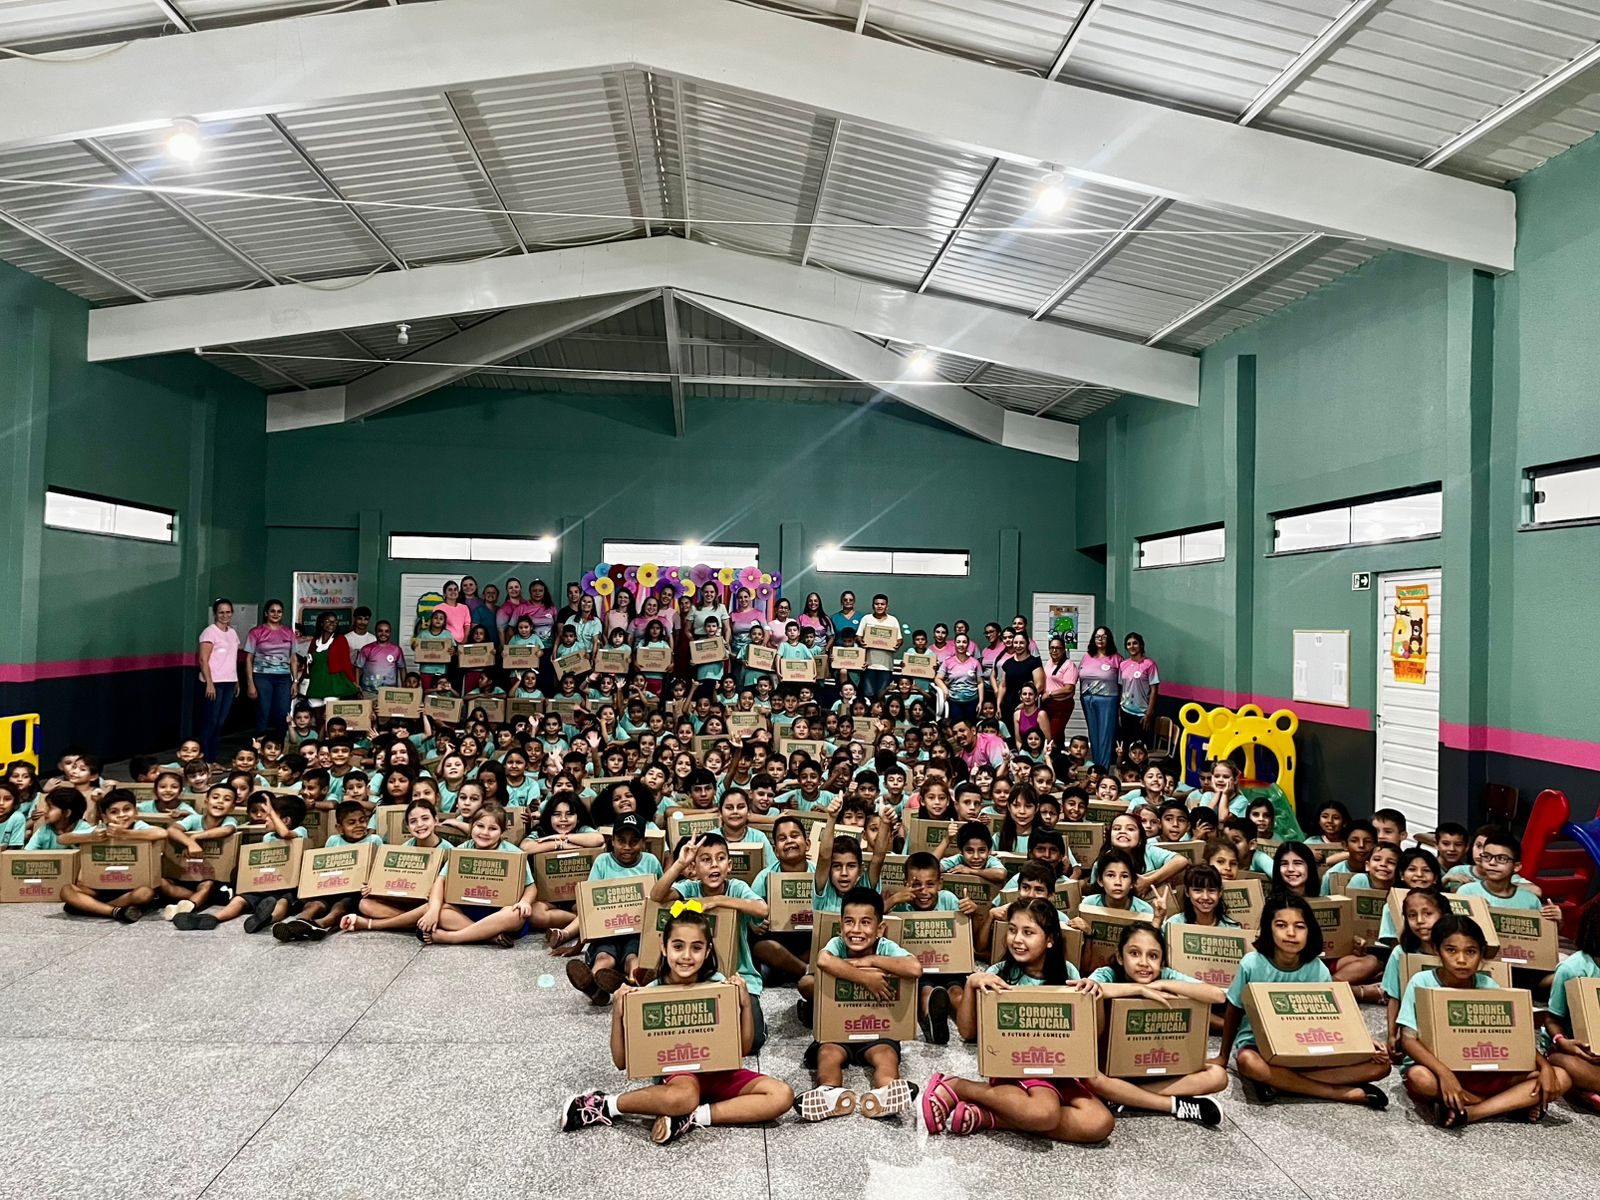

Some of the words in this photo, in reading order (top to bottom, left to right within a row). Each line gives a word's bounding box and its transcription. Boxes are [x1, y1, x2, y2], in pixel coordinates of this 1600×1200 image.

[326, 852, 352, 862] CORONEL
[399, 854, 424, 863] CORONEL
[559, 858, 587, 866] CORONEL
[325, 859, 354, 868] SAPUCAIA
[398, 861, 426, 870] SAPUCAIA
[473, 860, 502, 868] CORONEL
[559, 864, 590, 872] SAPUCAIA
[472, 867, 504, 876] SAPUCAIA
[253, 874, 282, 884] SEMEC
[317, 878, 349, 889] SEMEC
[385, 880, 416, 890] SEMEC
[555, 884, 576, 895] SEM
[464, 888, 499, 897] SEMEC
[607, 886, 636, 896] CORONEL
[608, 892, 642, 903] SAPUCAIA
[604, 916, 640, 928] SEMEC
[791, 914, 813, 922] SEM
[1500, 916, 1534, 928] CORONEL
[915, 929, 952, 938] SAPUCAIA
[1501, 925, 1538, 936] SAPUCAIA
[1201, 937, 1238, 948] CORONEL
[1201, 946, 1242, 958] SAPUCAIA
[1502, 948, 1535, 958] EMEC
[1194, 971, 1235, 984] SEME
[1288, 994, 1329, 1004] CORONEL
[664, 1002, 708, 1016] CORONEL
[1018, 1006, 1064, 1018] CORONEL
[1291, 1003, 1338, 1014] SAPUCAIA
[1467, 1004, 1506, 1015] CORONEL
[664, 1013, 714, 1027] SAPUCAIA
[1145, 1012, 1183, 1022] CORONEL
[1467, 1014, 1512, 1026] SAPUCAIA
[844, 1019, 890, 1030] SEMEC
[1019, 1018, 1070, 1030] SAPUCAIA
[1144, 1022, 1186, 1032] SAPUCAIA
[1295, 1032, 1344, 1042] SEMEC
[657, 1047, 710, 1062] SEMEC
[1011, 1051, 1066, 1063] SEMEC
[1134, 1052, 1180, 1064] SEMEC
[1463, 1047, 1510, 1058] SEMEC
